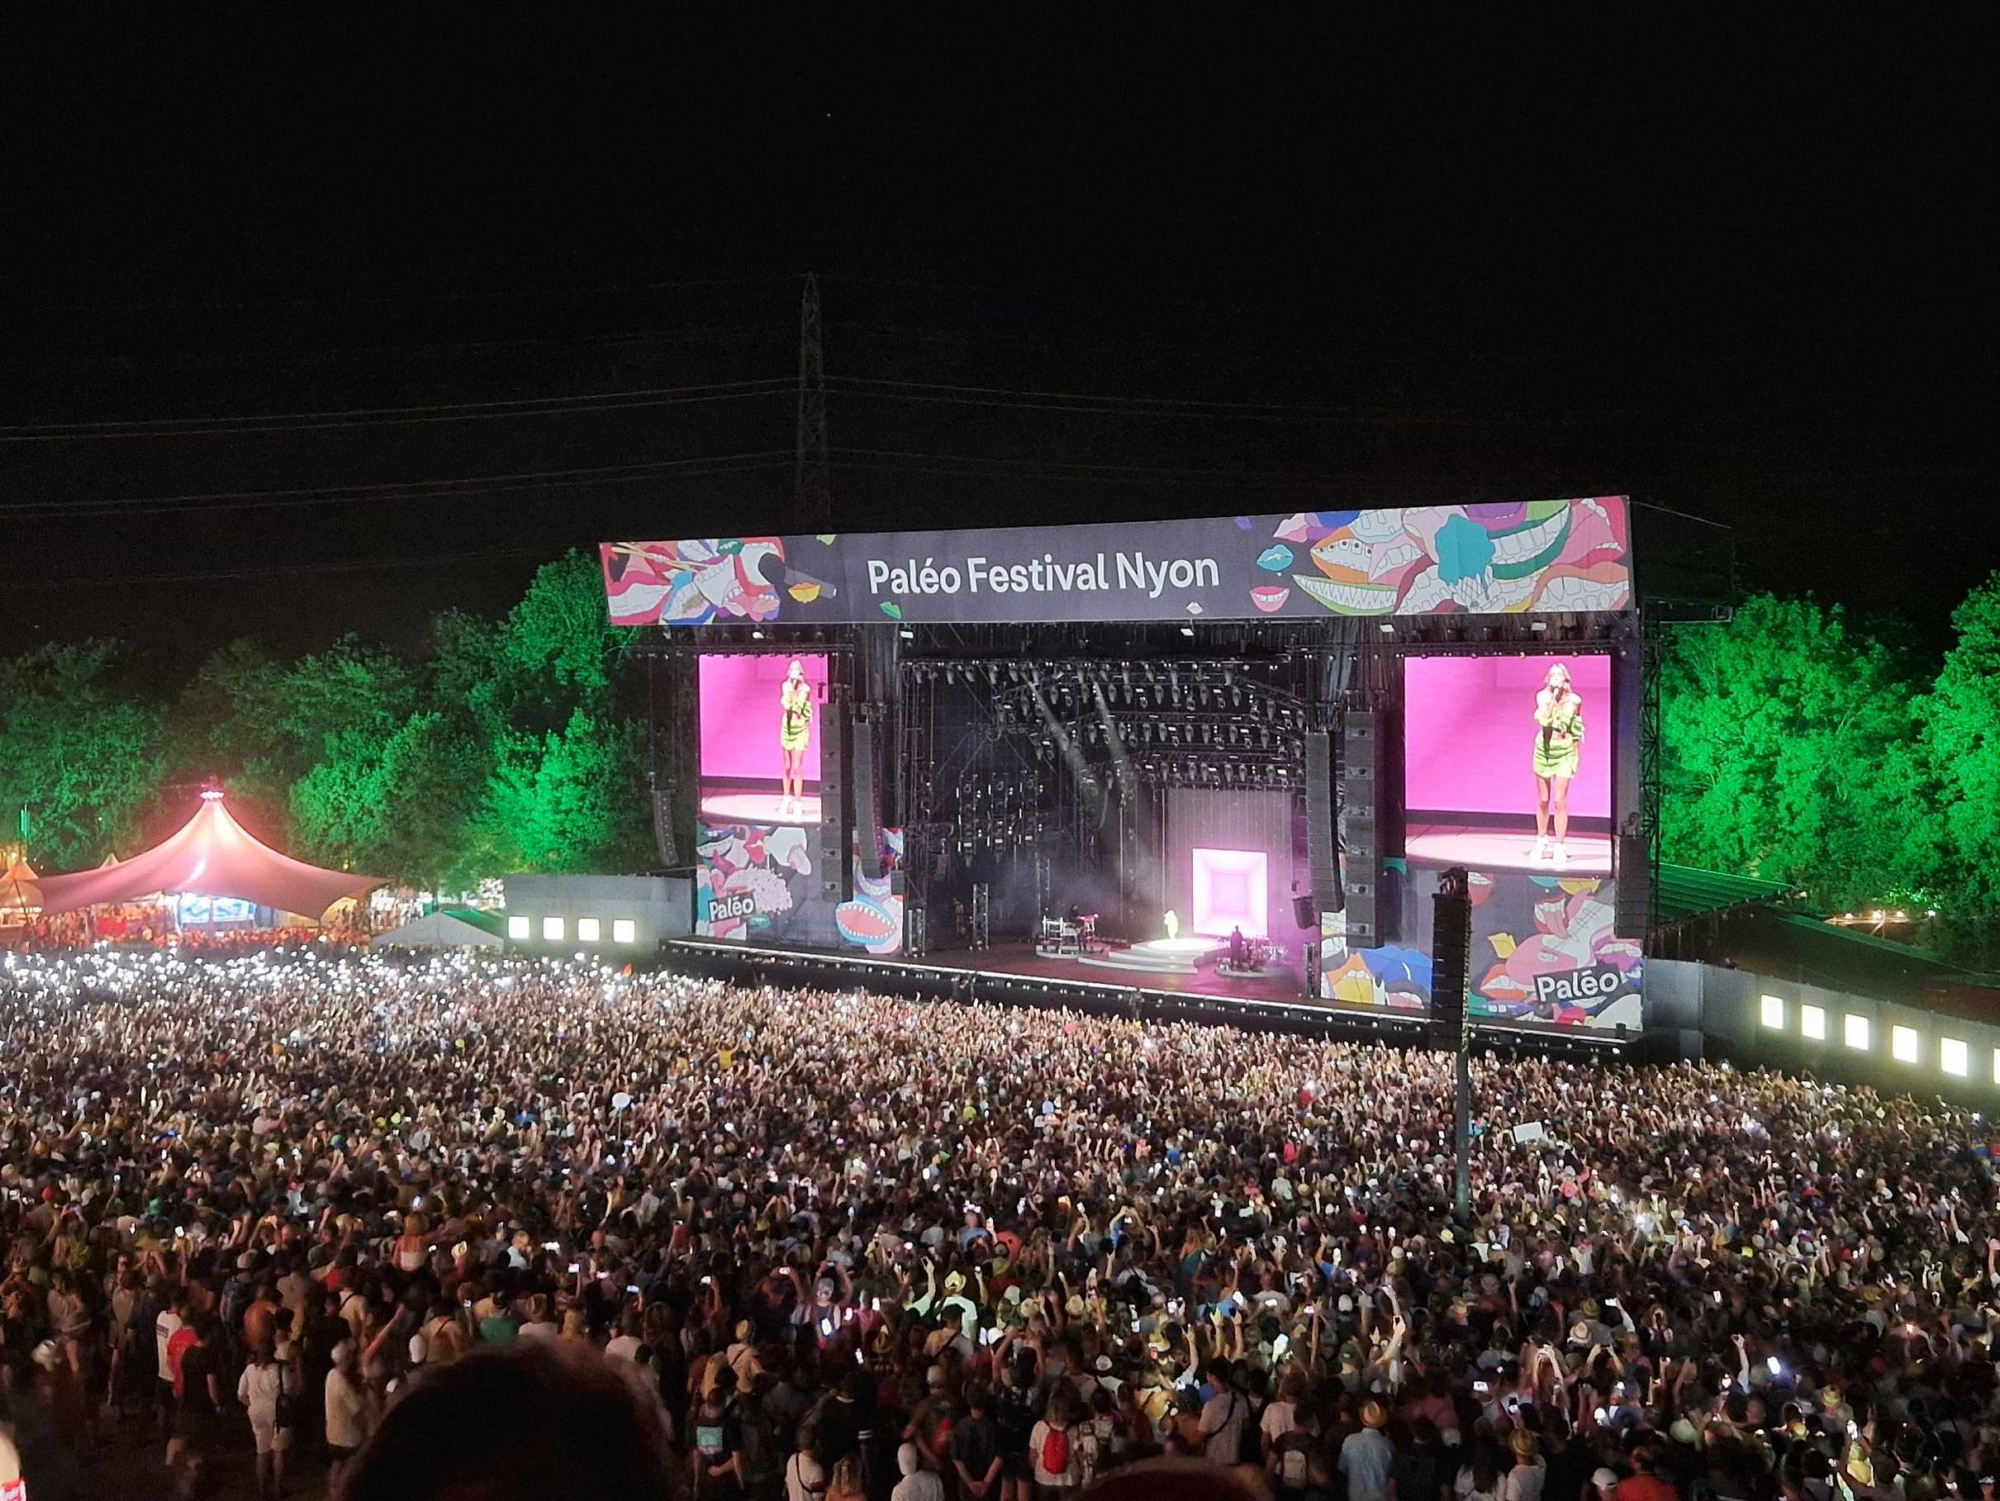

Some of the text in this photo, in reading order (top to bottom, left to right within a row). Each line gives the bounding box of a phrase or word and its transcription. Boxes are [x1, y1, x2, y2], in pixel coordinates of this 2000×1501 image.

[867, 552, 1220, 598] Paléo Festival Nyon
